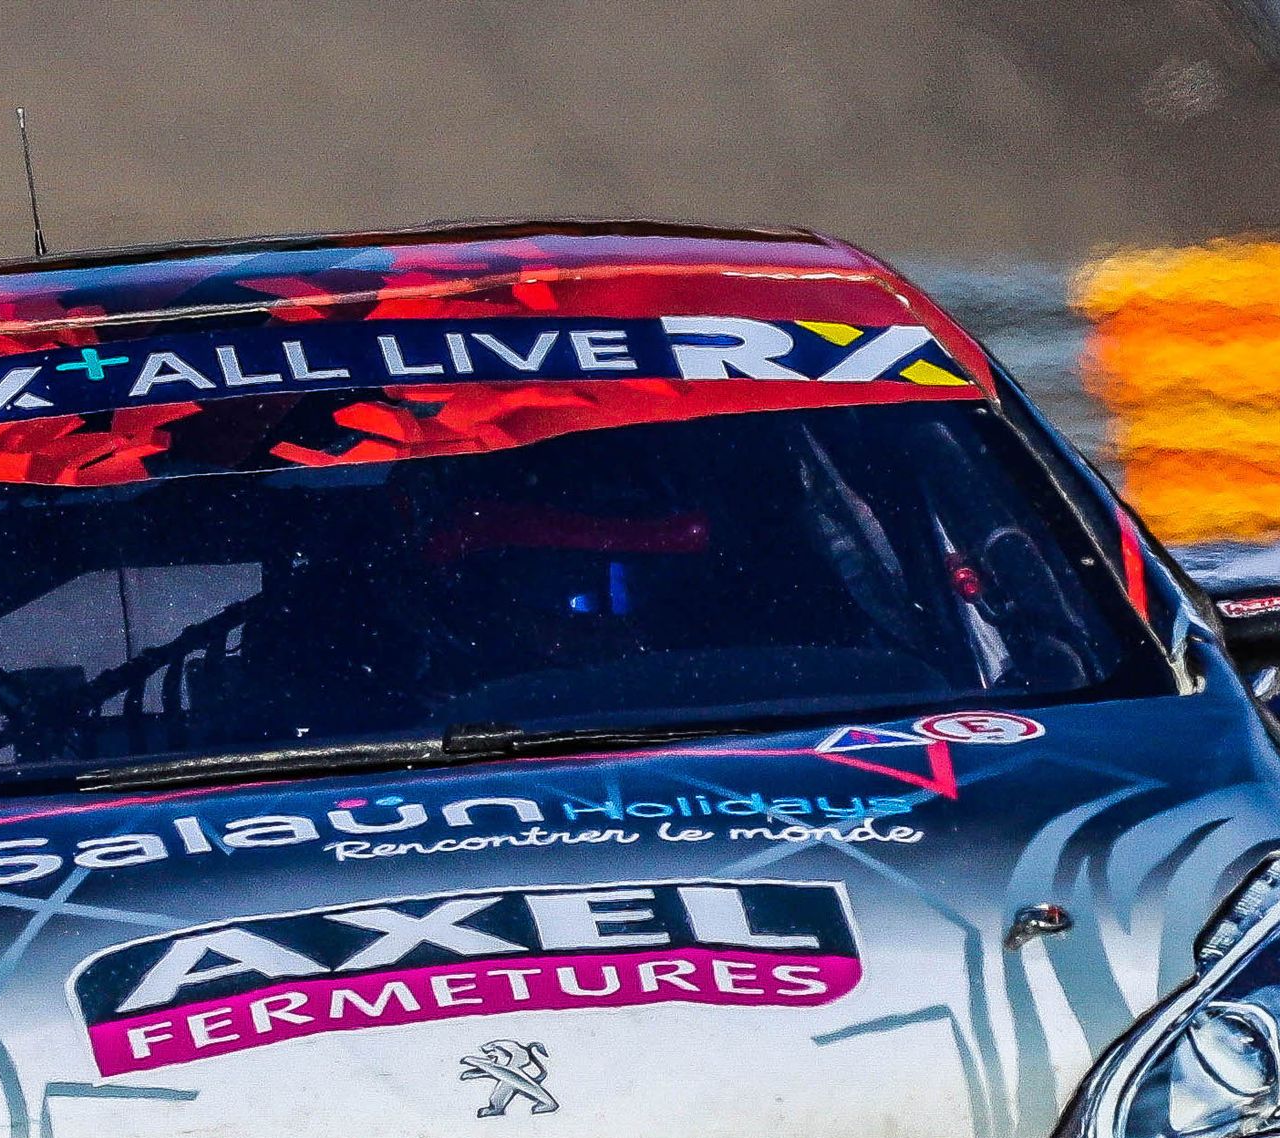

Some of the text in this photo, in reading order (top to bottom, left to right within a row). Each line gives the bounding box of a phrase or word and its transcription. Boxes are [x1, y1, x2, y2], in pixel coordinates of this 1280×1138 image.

[129, 341, 351, 398] ALL
[377, 328, 638, 377] LIVE
[661, 314, 974, 387] RX
[323, 818, 925, 862] Rencontrer le monde
[562, 793, 913, 820] Holidays
[115, 886, 819, 1013] AXEL
[127, 960, 826, 1060] FERMETURES
